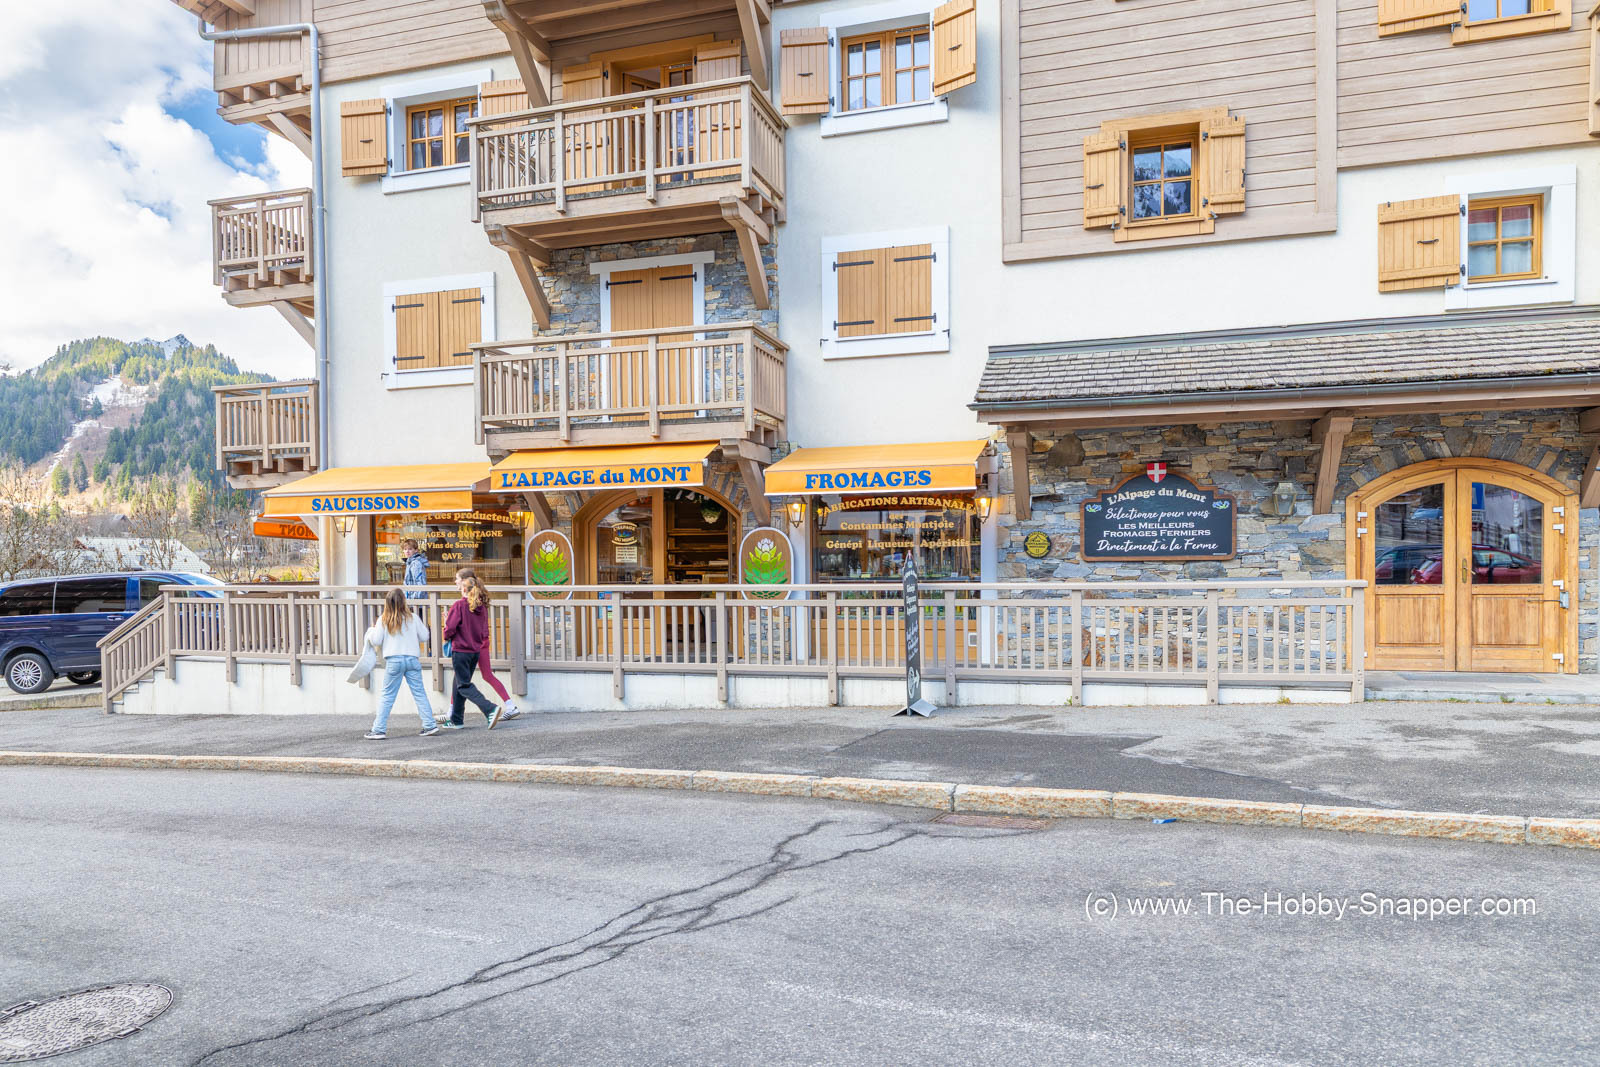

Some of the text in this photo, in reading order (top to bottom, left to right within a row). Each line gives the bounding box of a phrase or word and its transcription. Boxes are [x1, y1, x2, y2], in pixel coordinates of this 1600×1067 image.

[502, 466, 691, 487] L'ALPAGE du MONT
[805, 470, 932, 489] FROMAGES
[1107, 488, 1207, 505] L'Alpage du Mont
[311, 495, 420, 511] SAUCISSONS
[434, 512, 452, 520] des
[1105, 507, 1210, 522] Sélectionne pour vous
[840, 520, 955, 530] Contamines Montjoie
[457, 530, 503, 538] MONTAGNE
[1103, 529, 1211, 538] FROMAGES FERMIERS
[427, 541, 479, 549] Vins de Savoie
[826, 538, 970, 550] Génépi Liqueurs Apéritifs
[1096, 537, 1219, 552] Directement à la Ferme
[441, 552, 464, 560] CAVE
